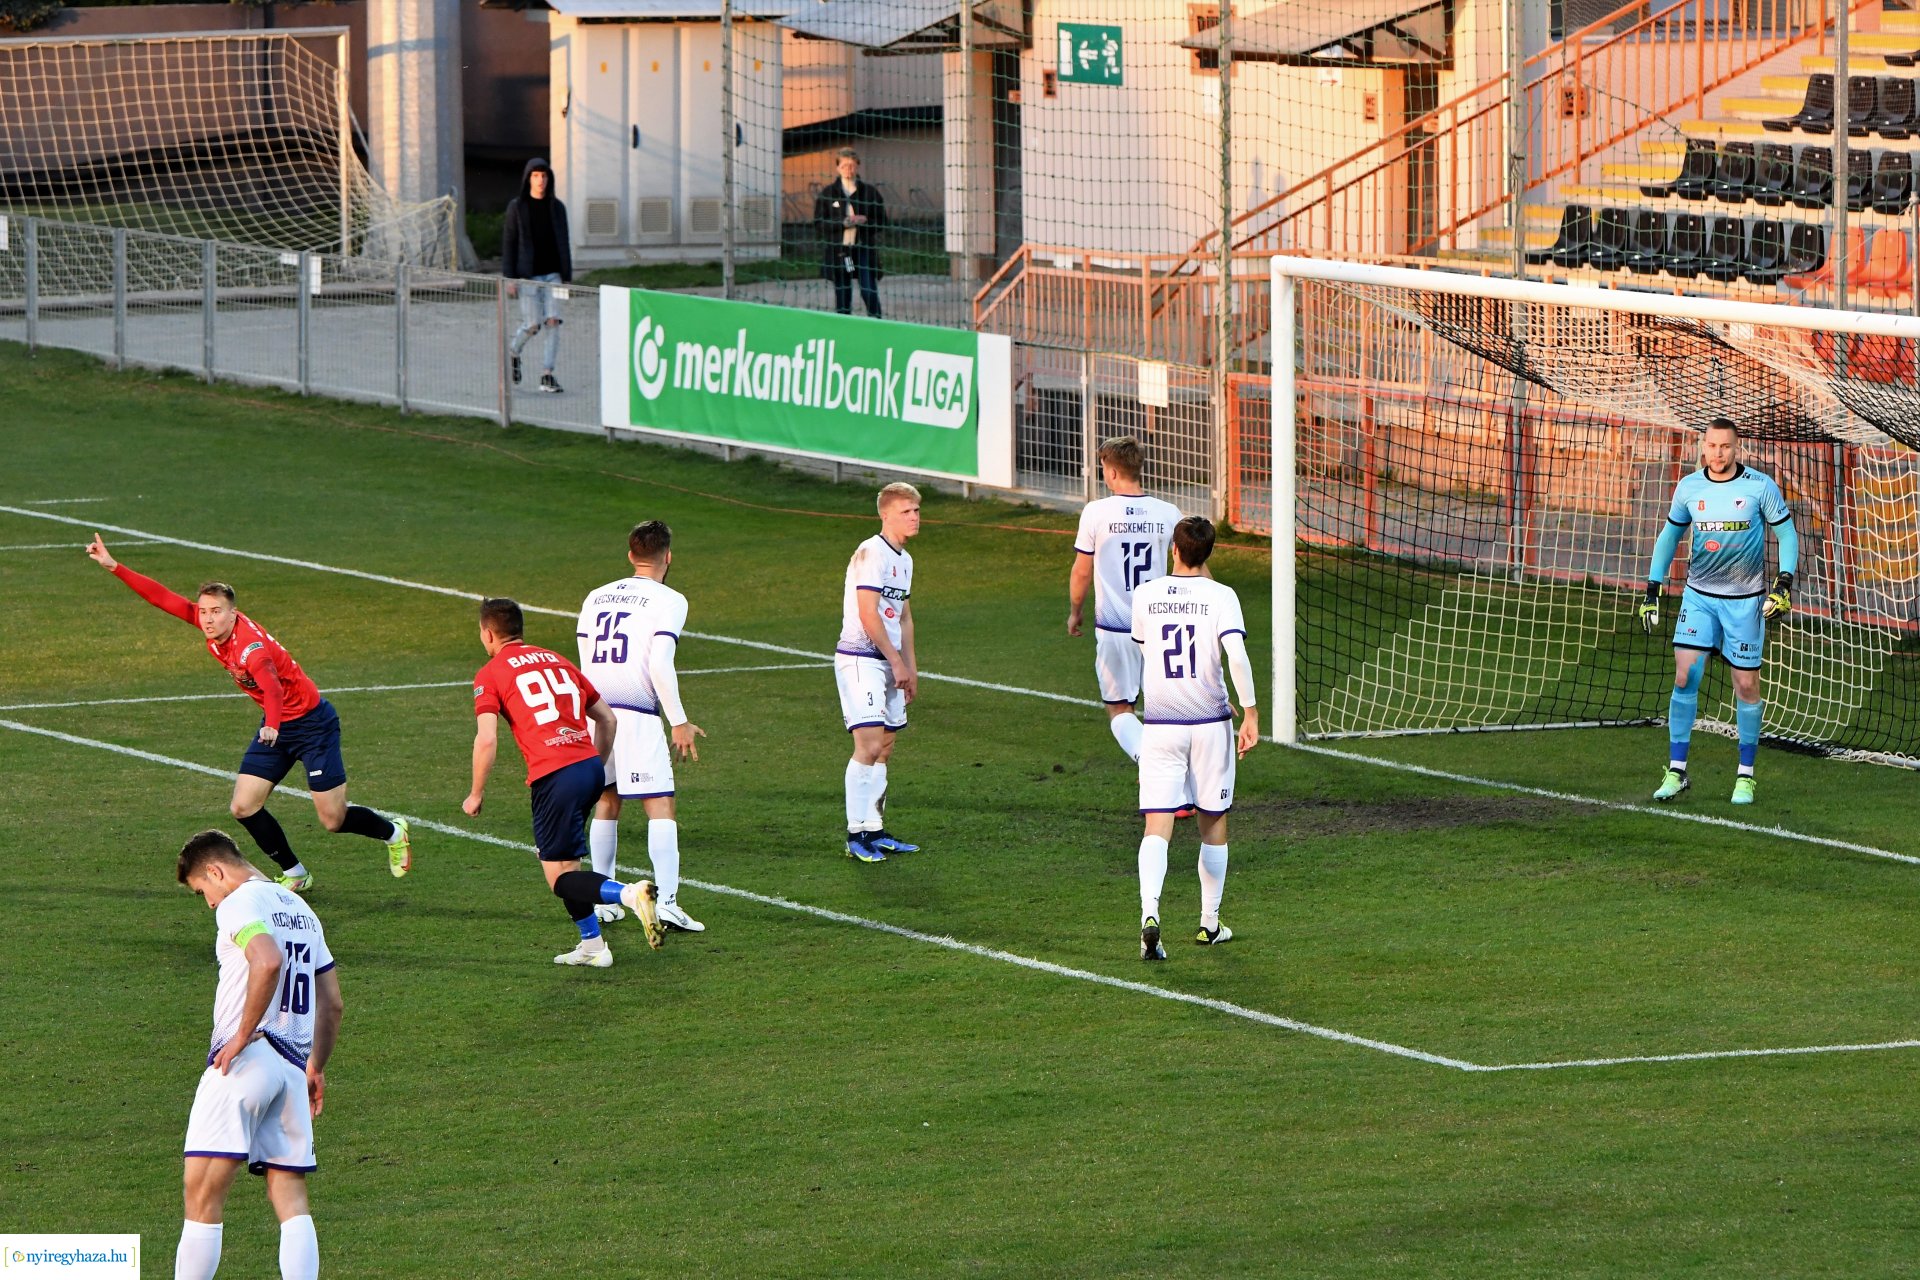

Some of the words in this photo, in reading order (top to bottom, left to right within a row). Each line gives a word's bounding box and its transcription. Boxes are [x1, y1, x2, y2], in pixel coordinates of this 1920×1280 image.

[673, 328, 901, 420] merkantilbank
[911, 365, 965, 414] LIGA
[1108, 521, 1153, 534] KECSKEMÉTI
[1156, 522, 1165, 534] TE
[1121, 542, 1152, 592] 12
[639, 596, 650, 608] TE
[1148, 601, 1198, 615] KECSKEMÉTI
[1200, 603, 1209, 616] TE
[591, 611, 632, 664] 25
[1161, 624, 1197, 679] 21
[515, 668, 580, 726] 94
[867, 691, 874, 706] 3
[279, 940, 311, 1015] 16
